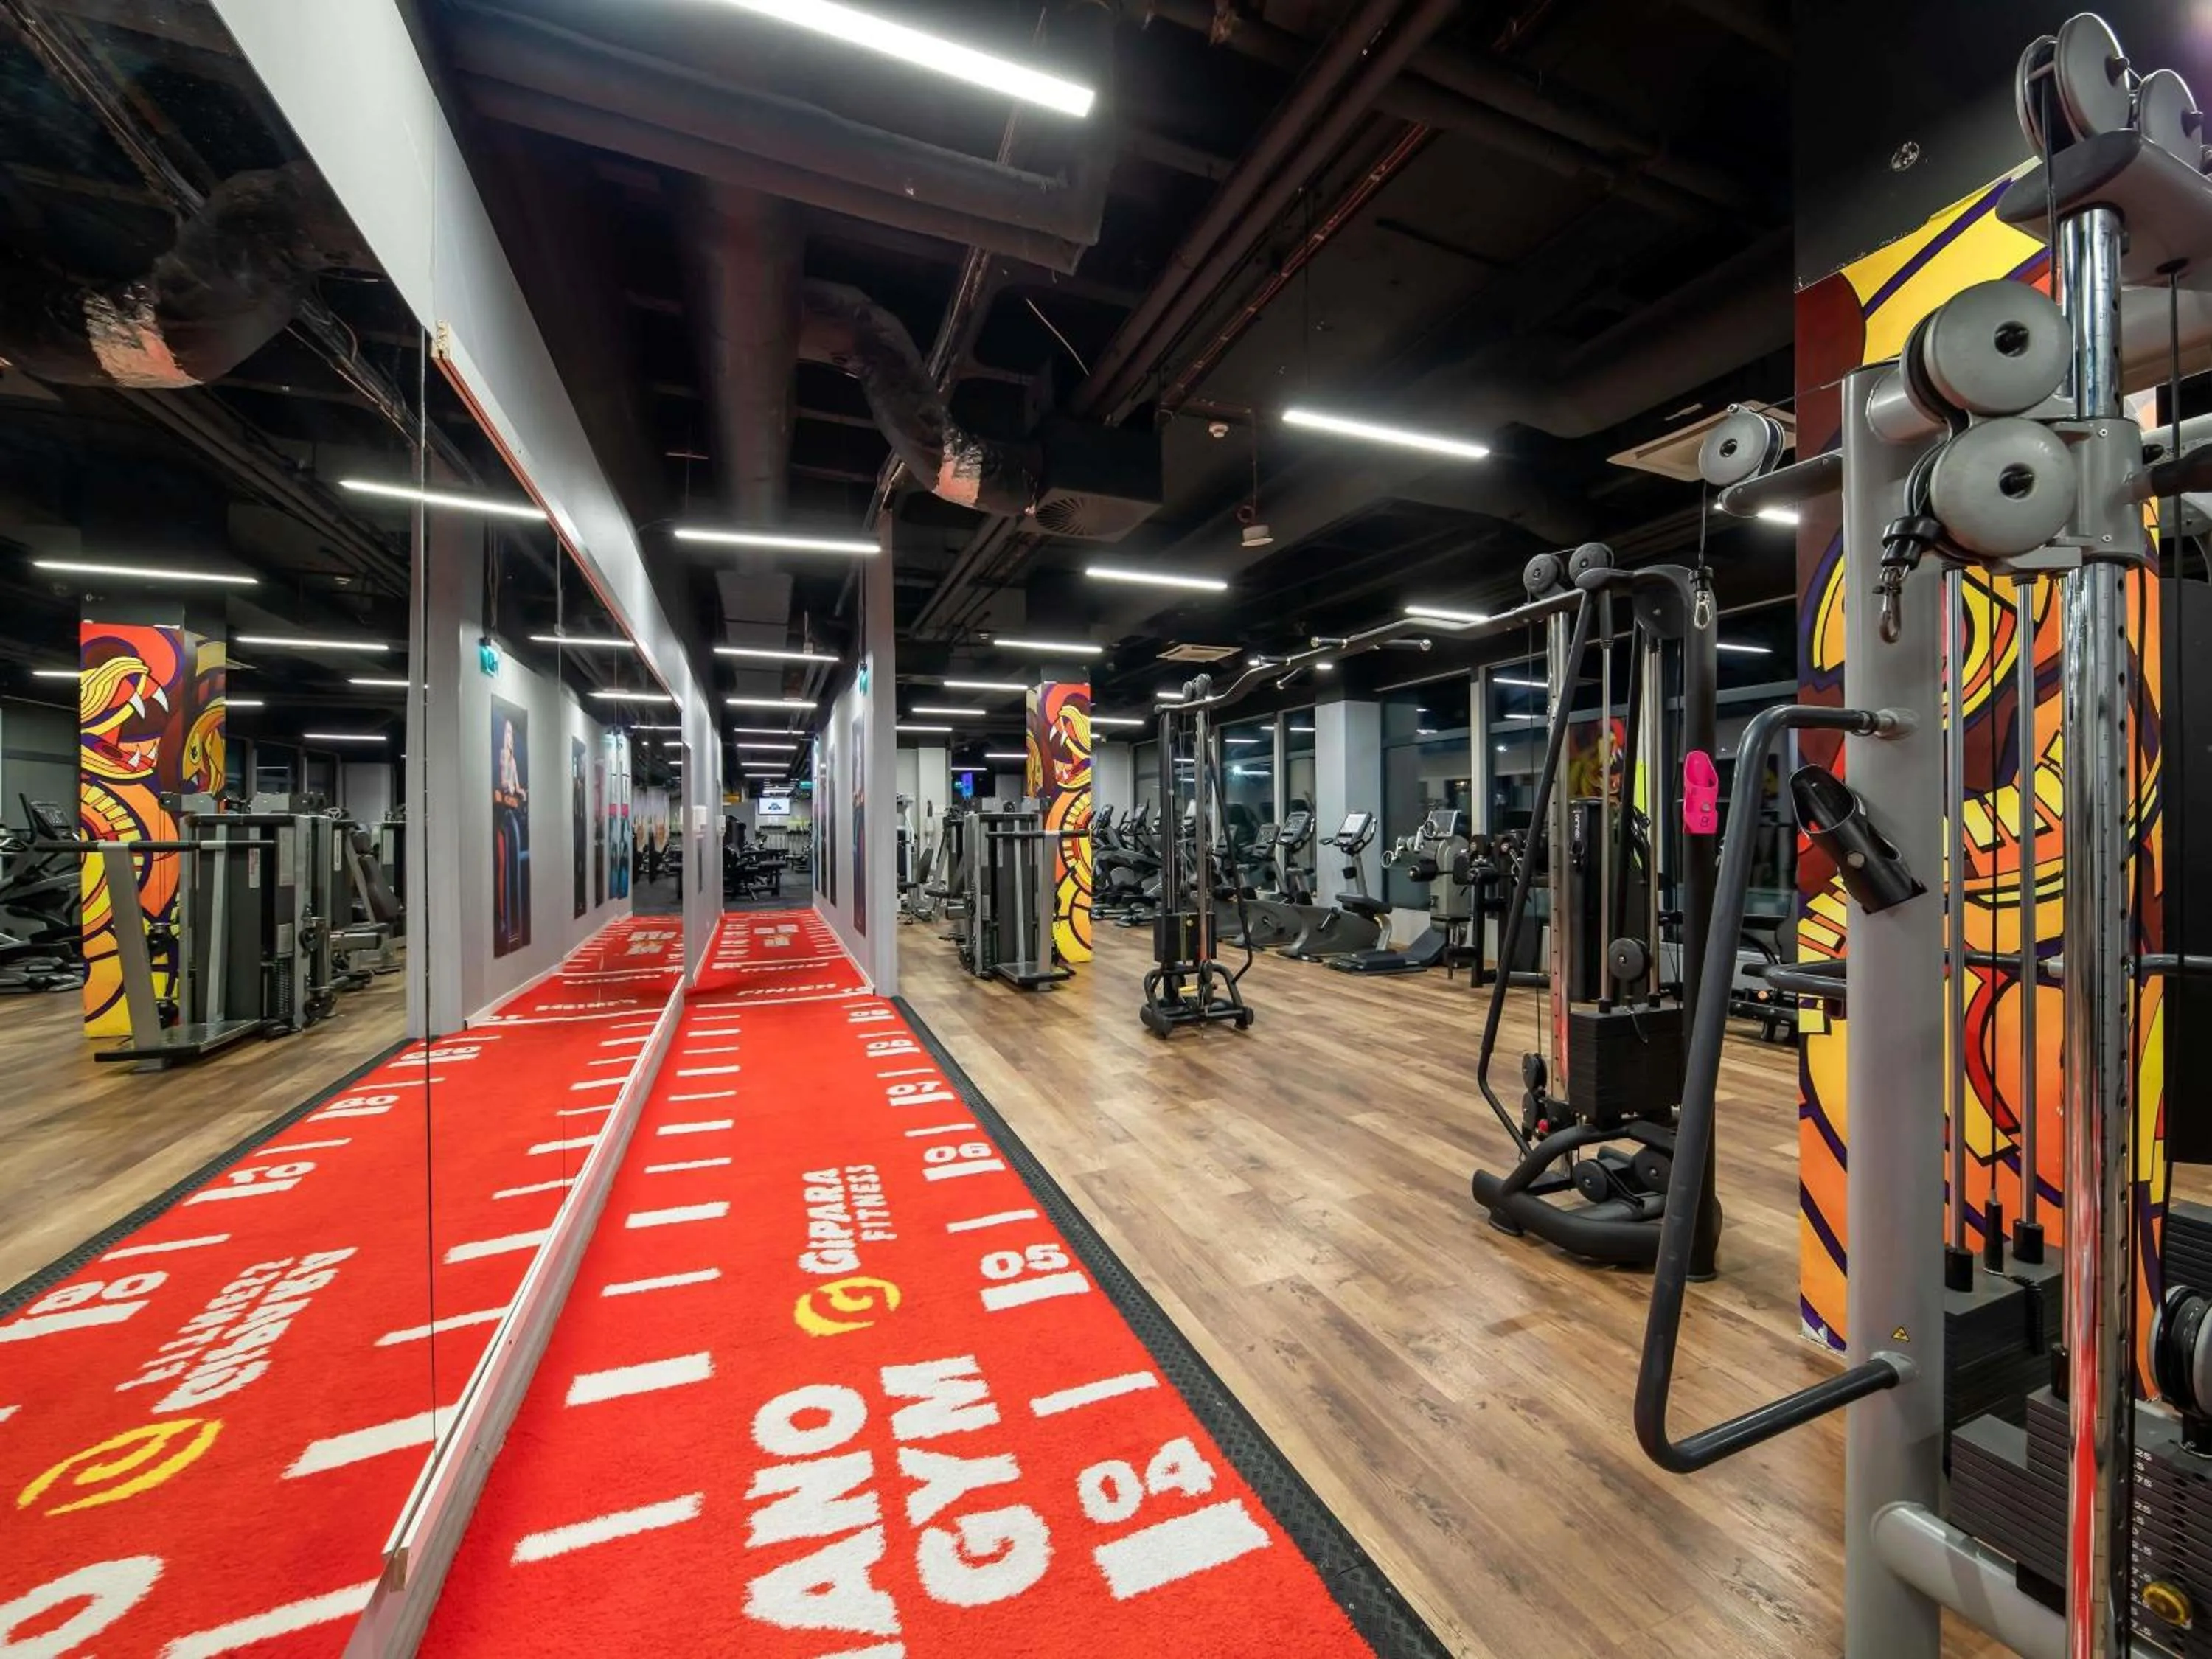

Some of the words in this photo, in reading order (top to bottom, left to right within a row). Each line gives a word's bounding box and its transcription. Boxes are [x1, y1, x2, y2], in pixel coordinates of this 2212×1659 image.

[886, 1080, 942, 1096] 07
[923, 1141, 992, 1163] 06
[844, 1164, 897, 1242] FITNESS
[979, 1243, 1070, 1279] 05
[880, 1354, 1054, 1608] GYM
[1075, 1436, 1217, 1524] 04
[742, 1383, 906, 1659] ANO
